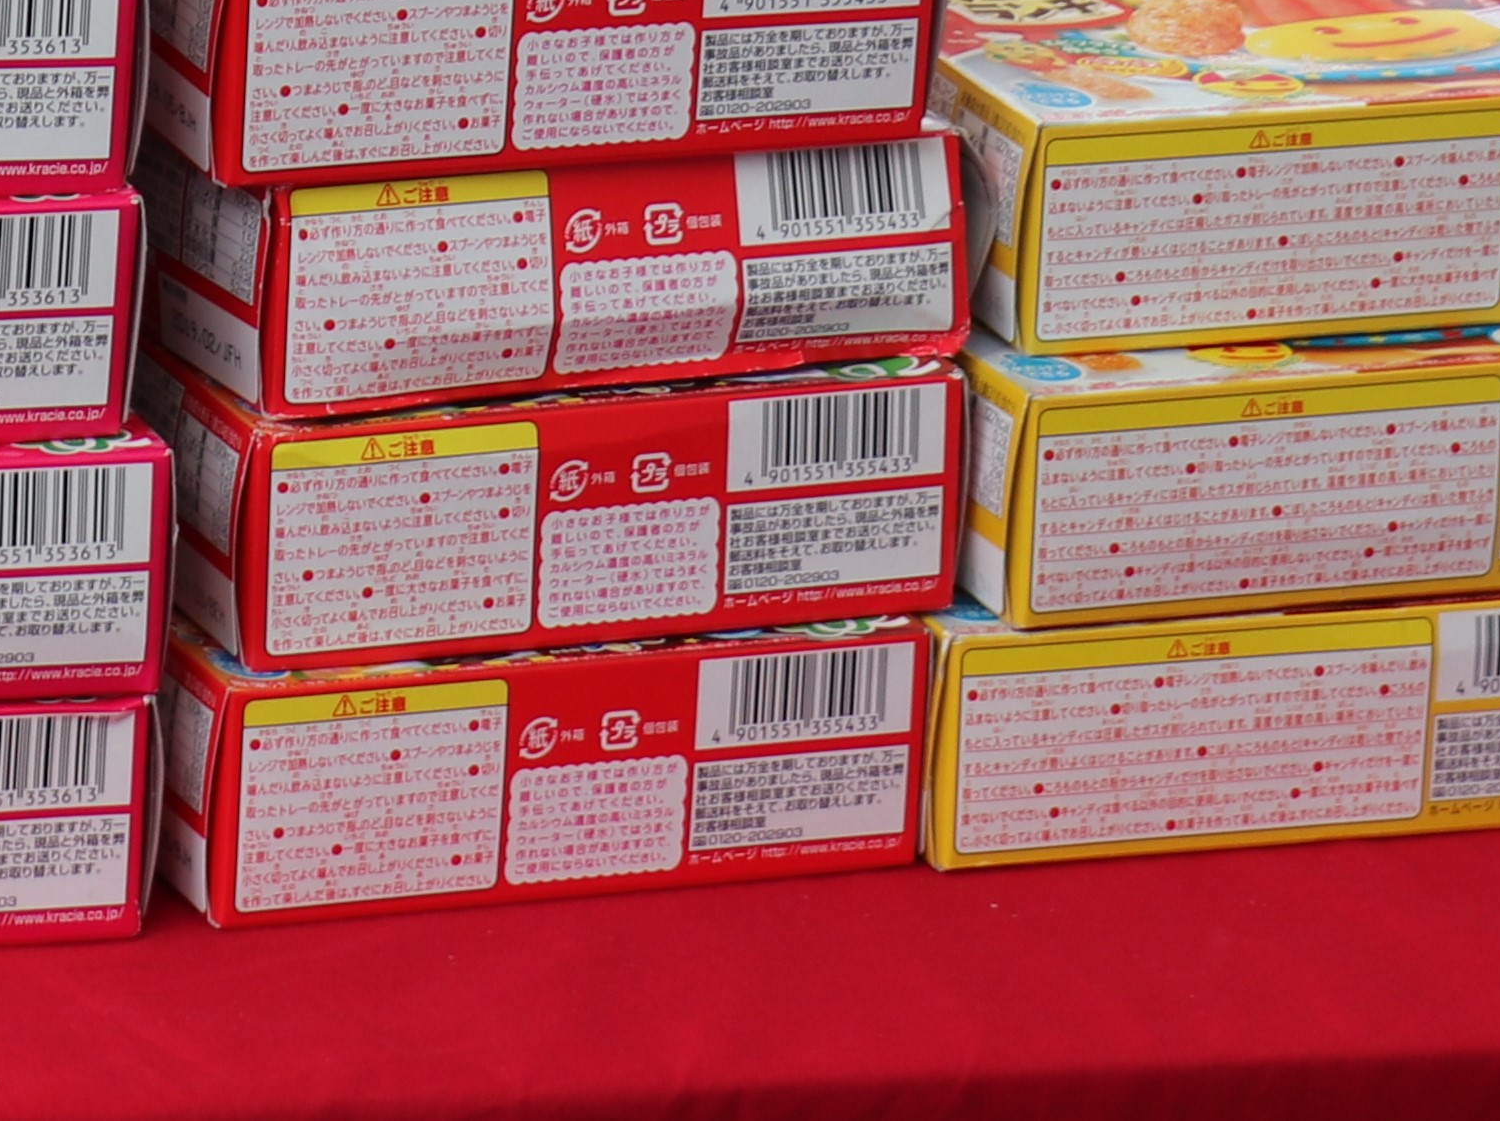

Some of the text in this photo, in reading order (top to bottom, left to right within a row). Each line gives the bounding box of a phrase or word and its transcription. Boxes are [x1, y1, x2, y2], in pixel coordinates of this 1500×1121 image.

[7, 38, 81, 55] 353613
[744, 457, 912, 485] 4 901551 355433
[44, 545, 116, 562] 353613
